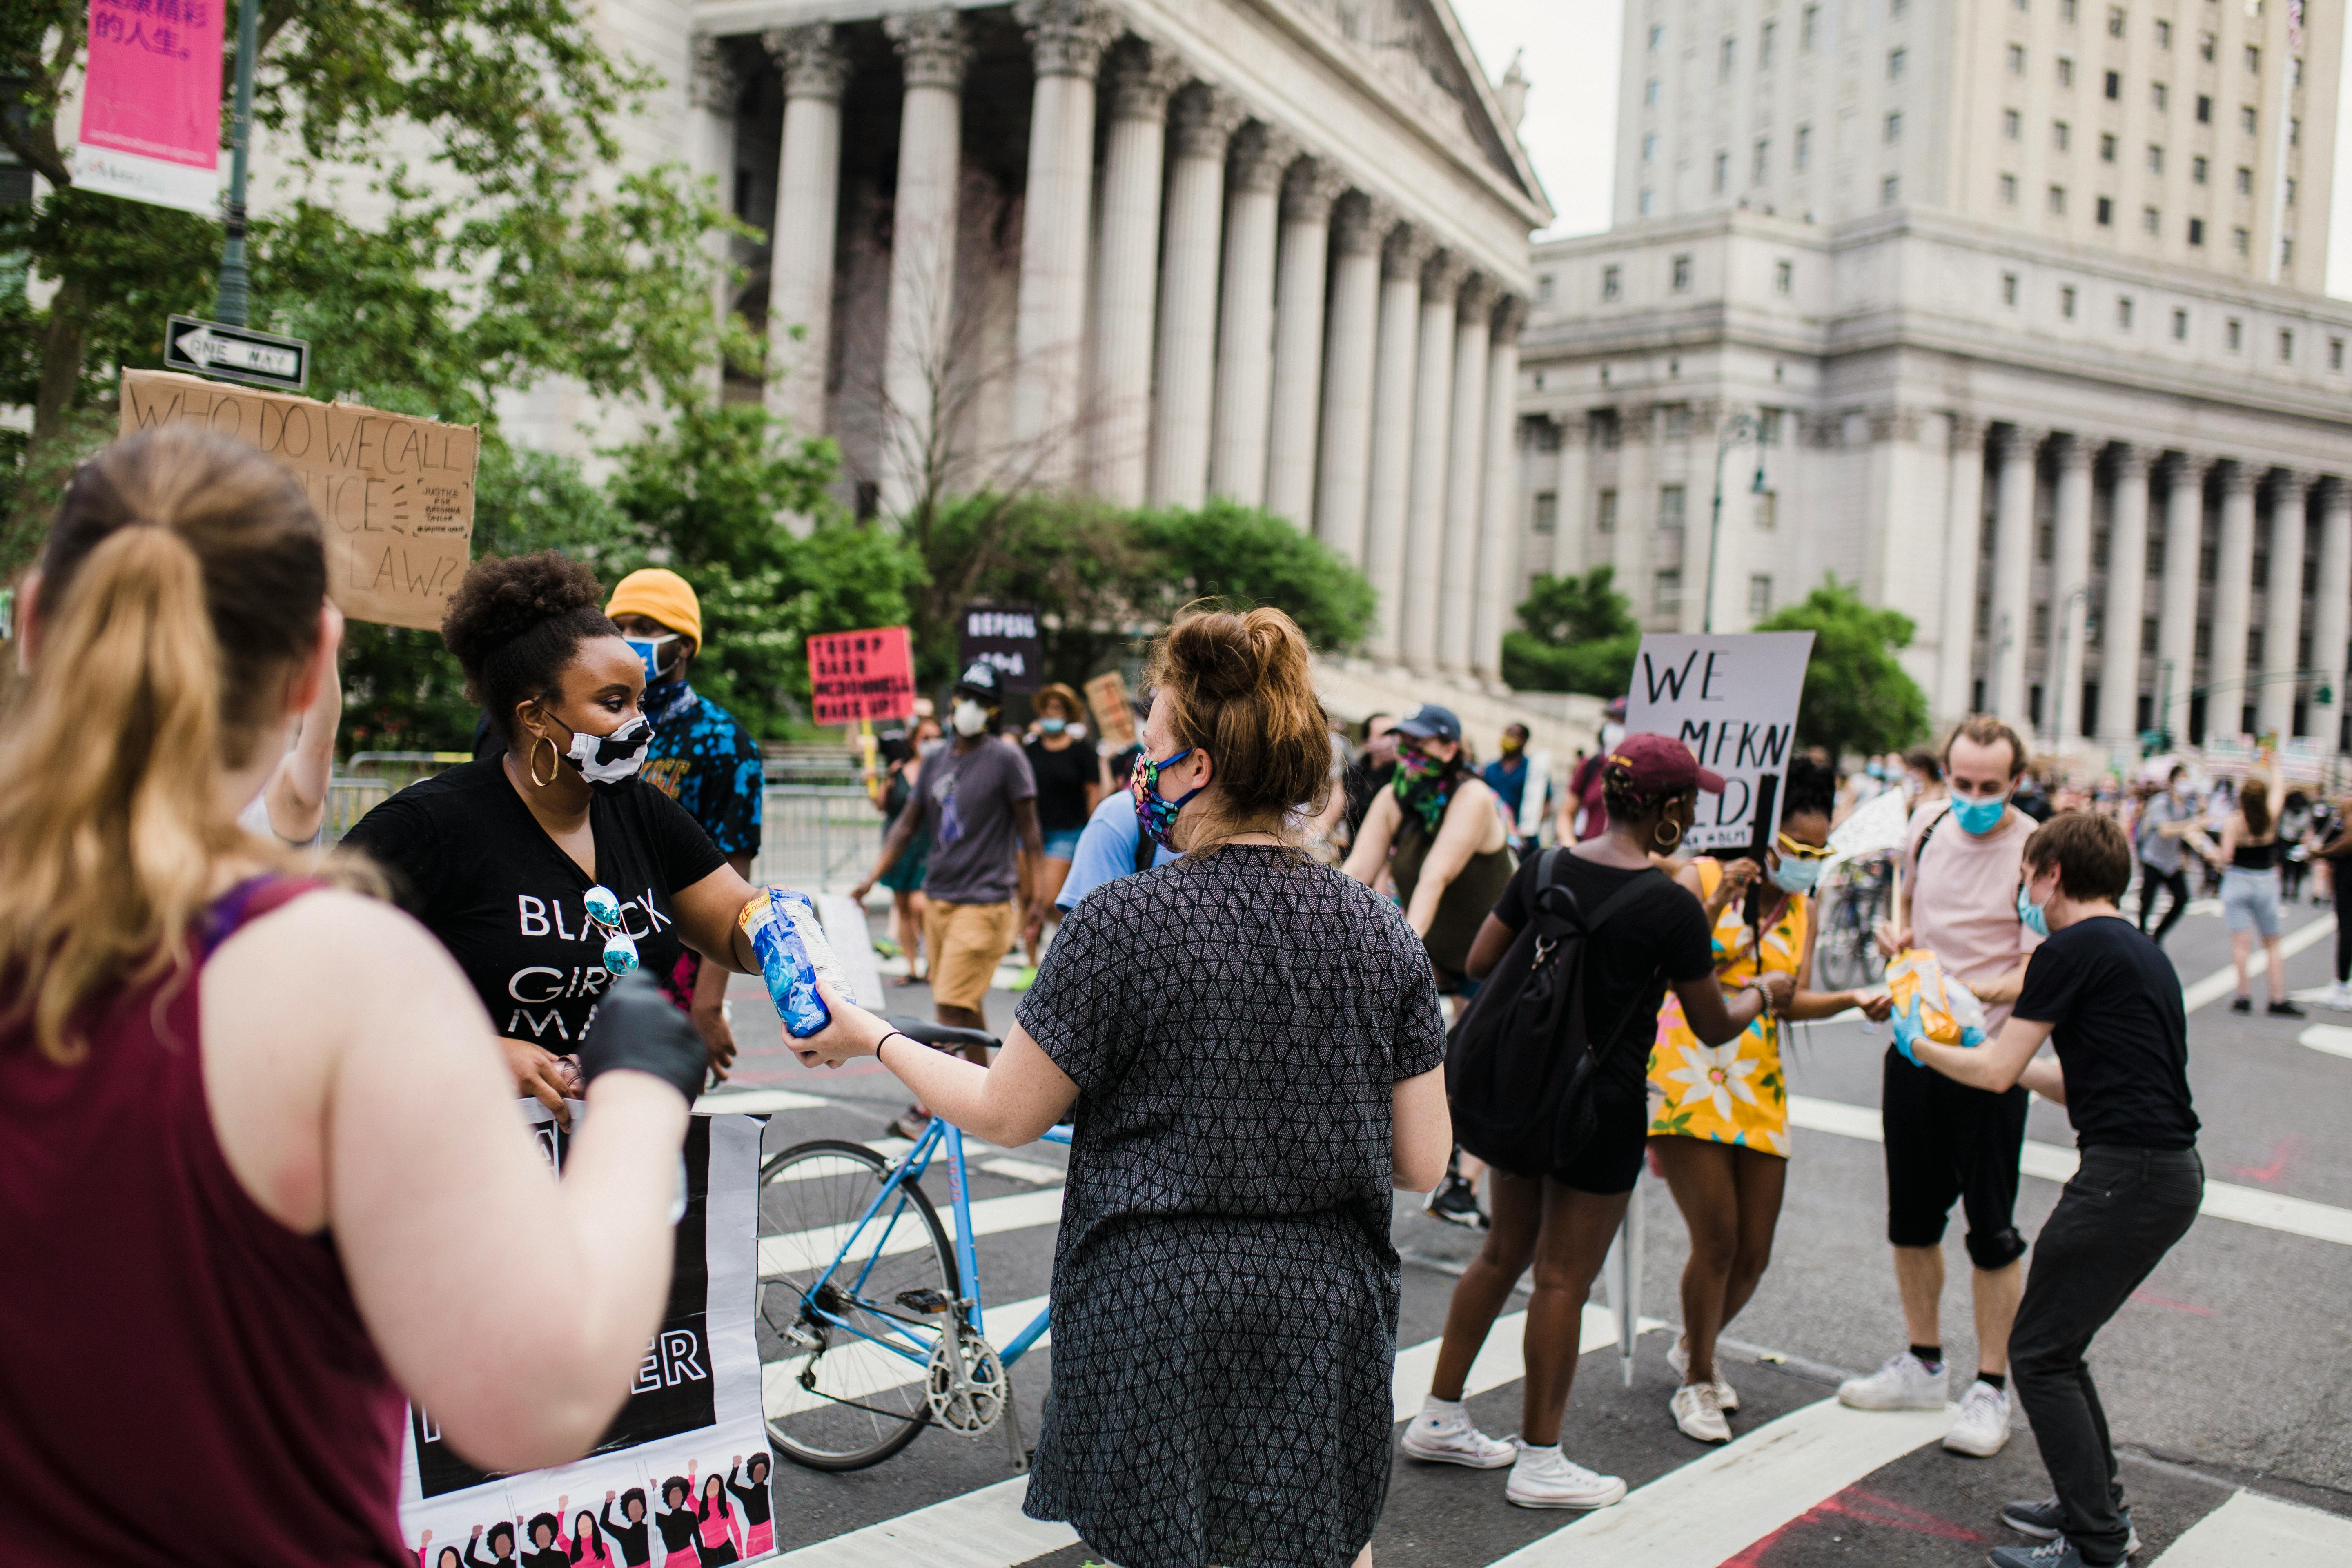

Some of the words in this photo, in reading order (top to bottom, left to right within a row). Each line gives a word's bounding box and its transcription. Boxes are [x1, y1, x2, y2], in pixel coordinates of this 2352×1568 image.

[190, 337, 227, 363] ONE
[247, 349, 285, 372] WAY
[130, 383, 242, 438] WHO
[260, 399, 310, 458] DO
[325, 410, 377, 471] WE
[383, 420, 463, 475] CALL
[422, 486, 459, 499] JUSTICE
[434, 497, 451, 505] FOR
[425, 505, 461, 514] BREONNA
[425, 514, 453, 523] TAYLOR
[350, 540, 458, 597] LAW?
[1643, 650, 1730, 705] WE
[1680, 719, 1791, 768] MFKN
[793, 1022, 802, 1032] 200
[802, 1011, 822, 1025] DROPS
